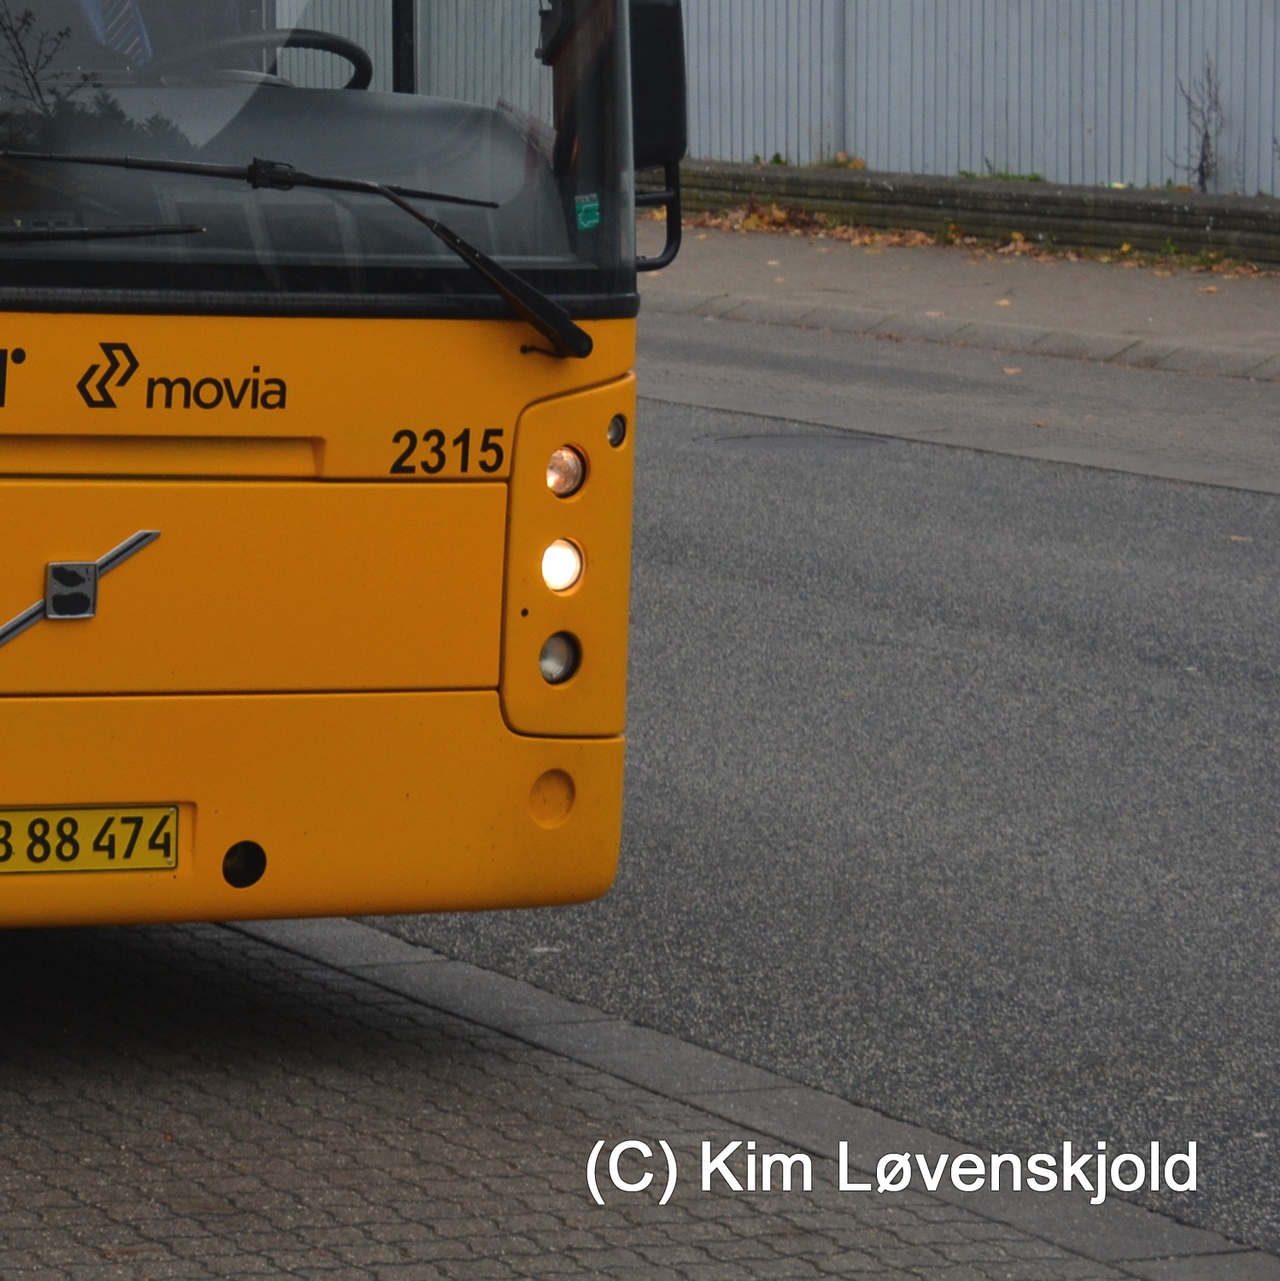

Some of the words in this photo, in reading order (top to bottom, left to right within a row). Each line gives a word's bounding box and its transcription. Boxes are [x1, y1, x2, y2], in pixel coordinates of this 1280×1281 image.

[146, 365, 287, 409] movia
[390, 428, 504, 474] 2315
[26, 817, 80, 863] 88
[92, 815, 171, 860] 474
